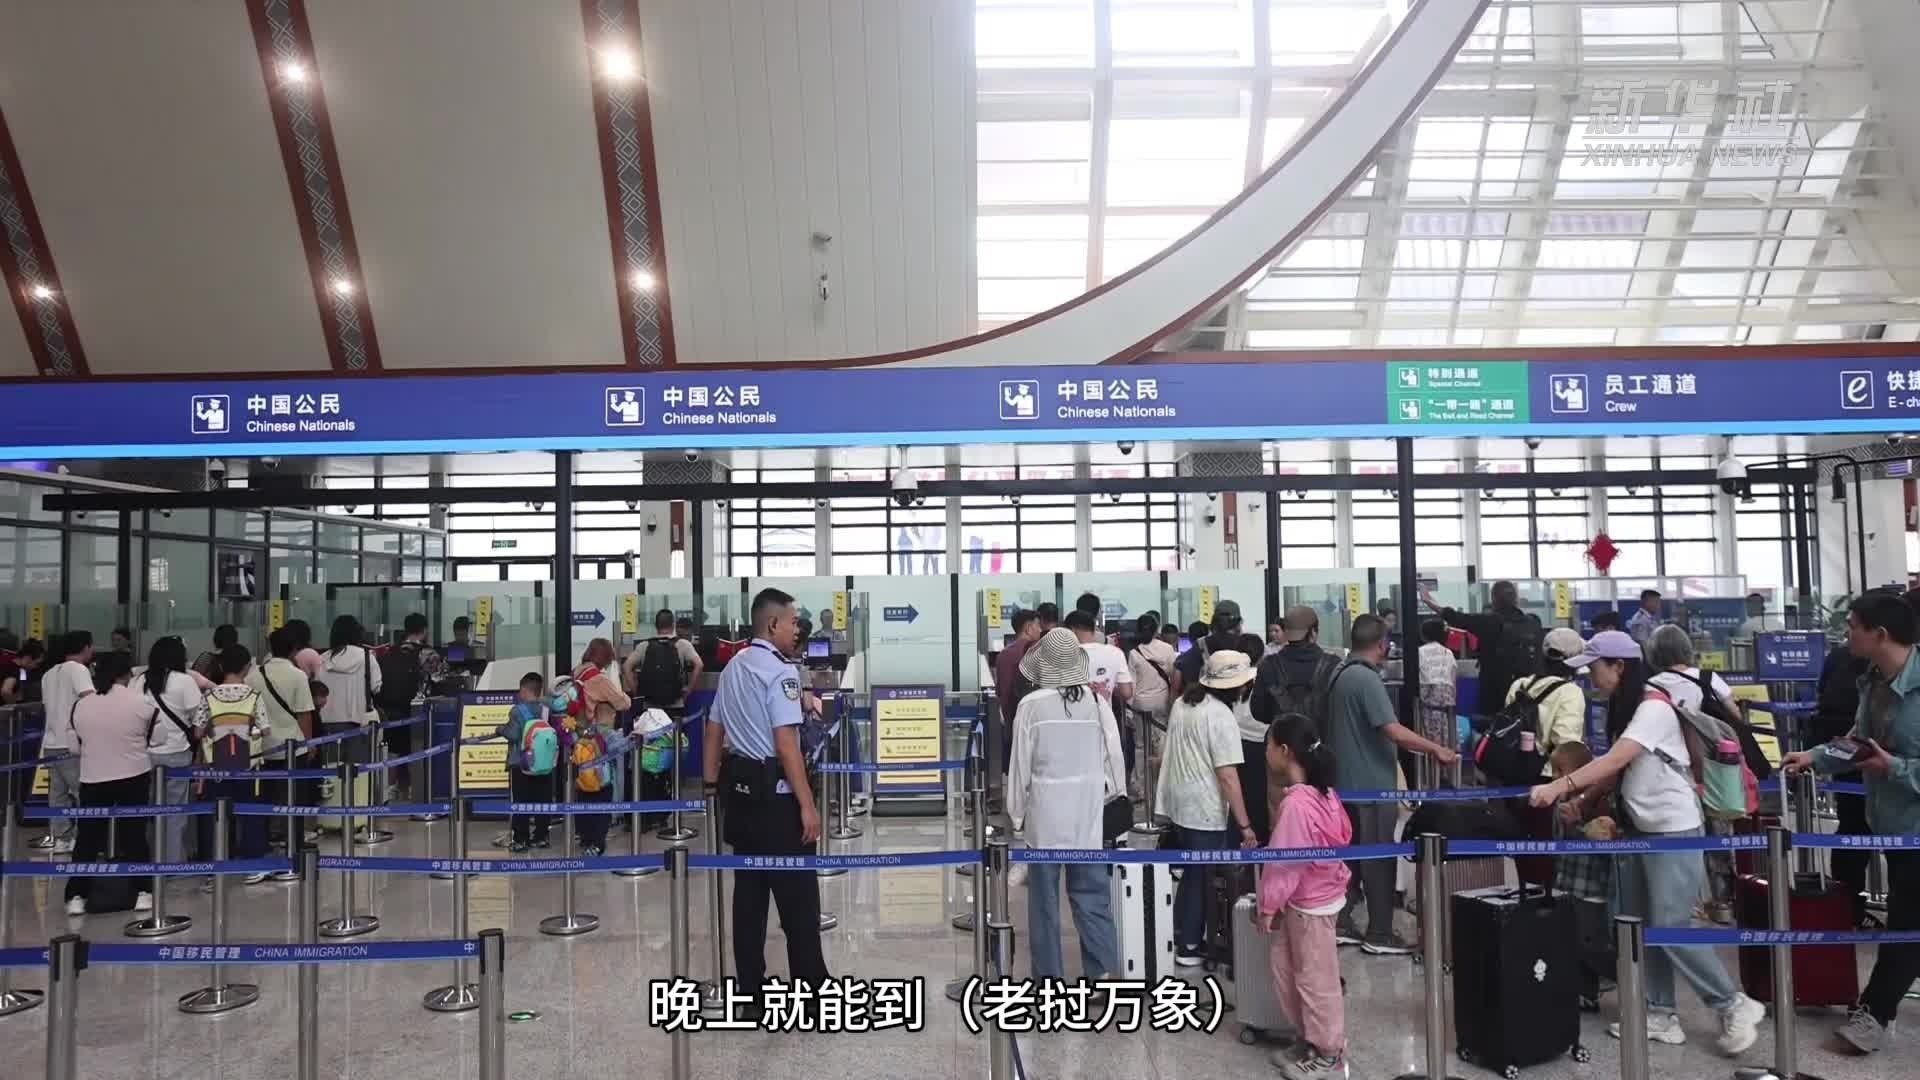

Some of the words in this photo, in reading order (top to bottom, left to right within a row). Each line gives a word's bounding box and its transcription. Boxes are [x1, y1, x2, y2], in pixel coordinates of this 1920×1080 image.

[1428, 367, 1479, 379] 特别通道
[1604, 373, 1697, 396] 员工通道
[1886, 370, 1920, 391] 快捷
[663, 385, 760, 408] 中国公民
[1057, 379, 1158, 401] 中国公民
[247, 393, 340, 416] 中国公民
[1057, 405, 1109, 419] Chinese
[1113, 404, 1176, 417] Nationals
[1605, 400, 1637, 413] Crew
[662, 412, 714, 425] Chinese
[718, 411, 777, 424] Nationals
[246, 420, 296, 433] Chinese
[299, 418, 356, 432] Nationals
[744, 857, 806, 867] 中国移民管理
[815, 856, 842, 866] CHINA
[845, 855, 901, 866] IMMIGRATION
[1023, 851, 1050, 860] CHINA
[1053, 851, 1109, 860] IMMIGRATION
[501, 861, 527, 871] CHINA
[529, 859, 585, 870] IMMIGRATION
[159, 945, 242, 960] 中国移民管理
[254, 947, 289, 958] CHINA
[293, 945, 368, 958] IMMIGRATION
[464, 942, 475, 953] 中
